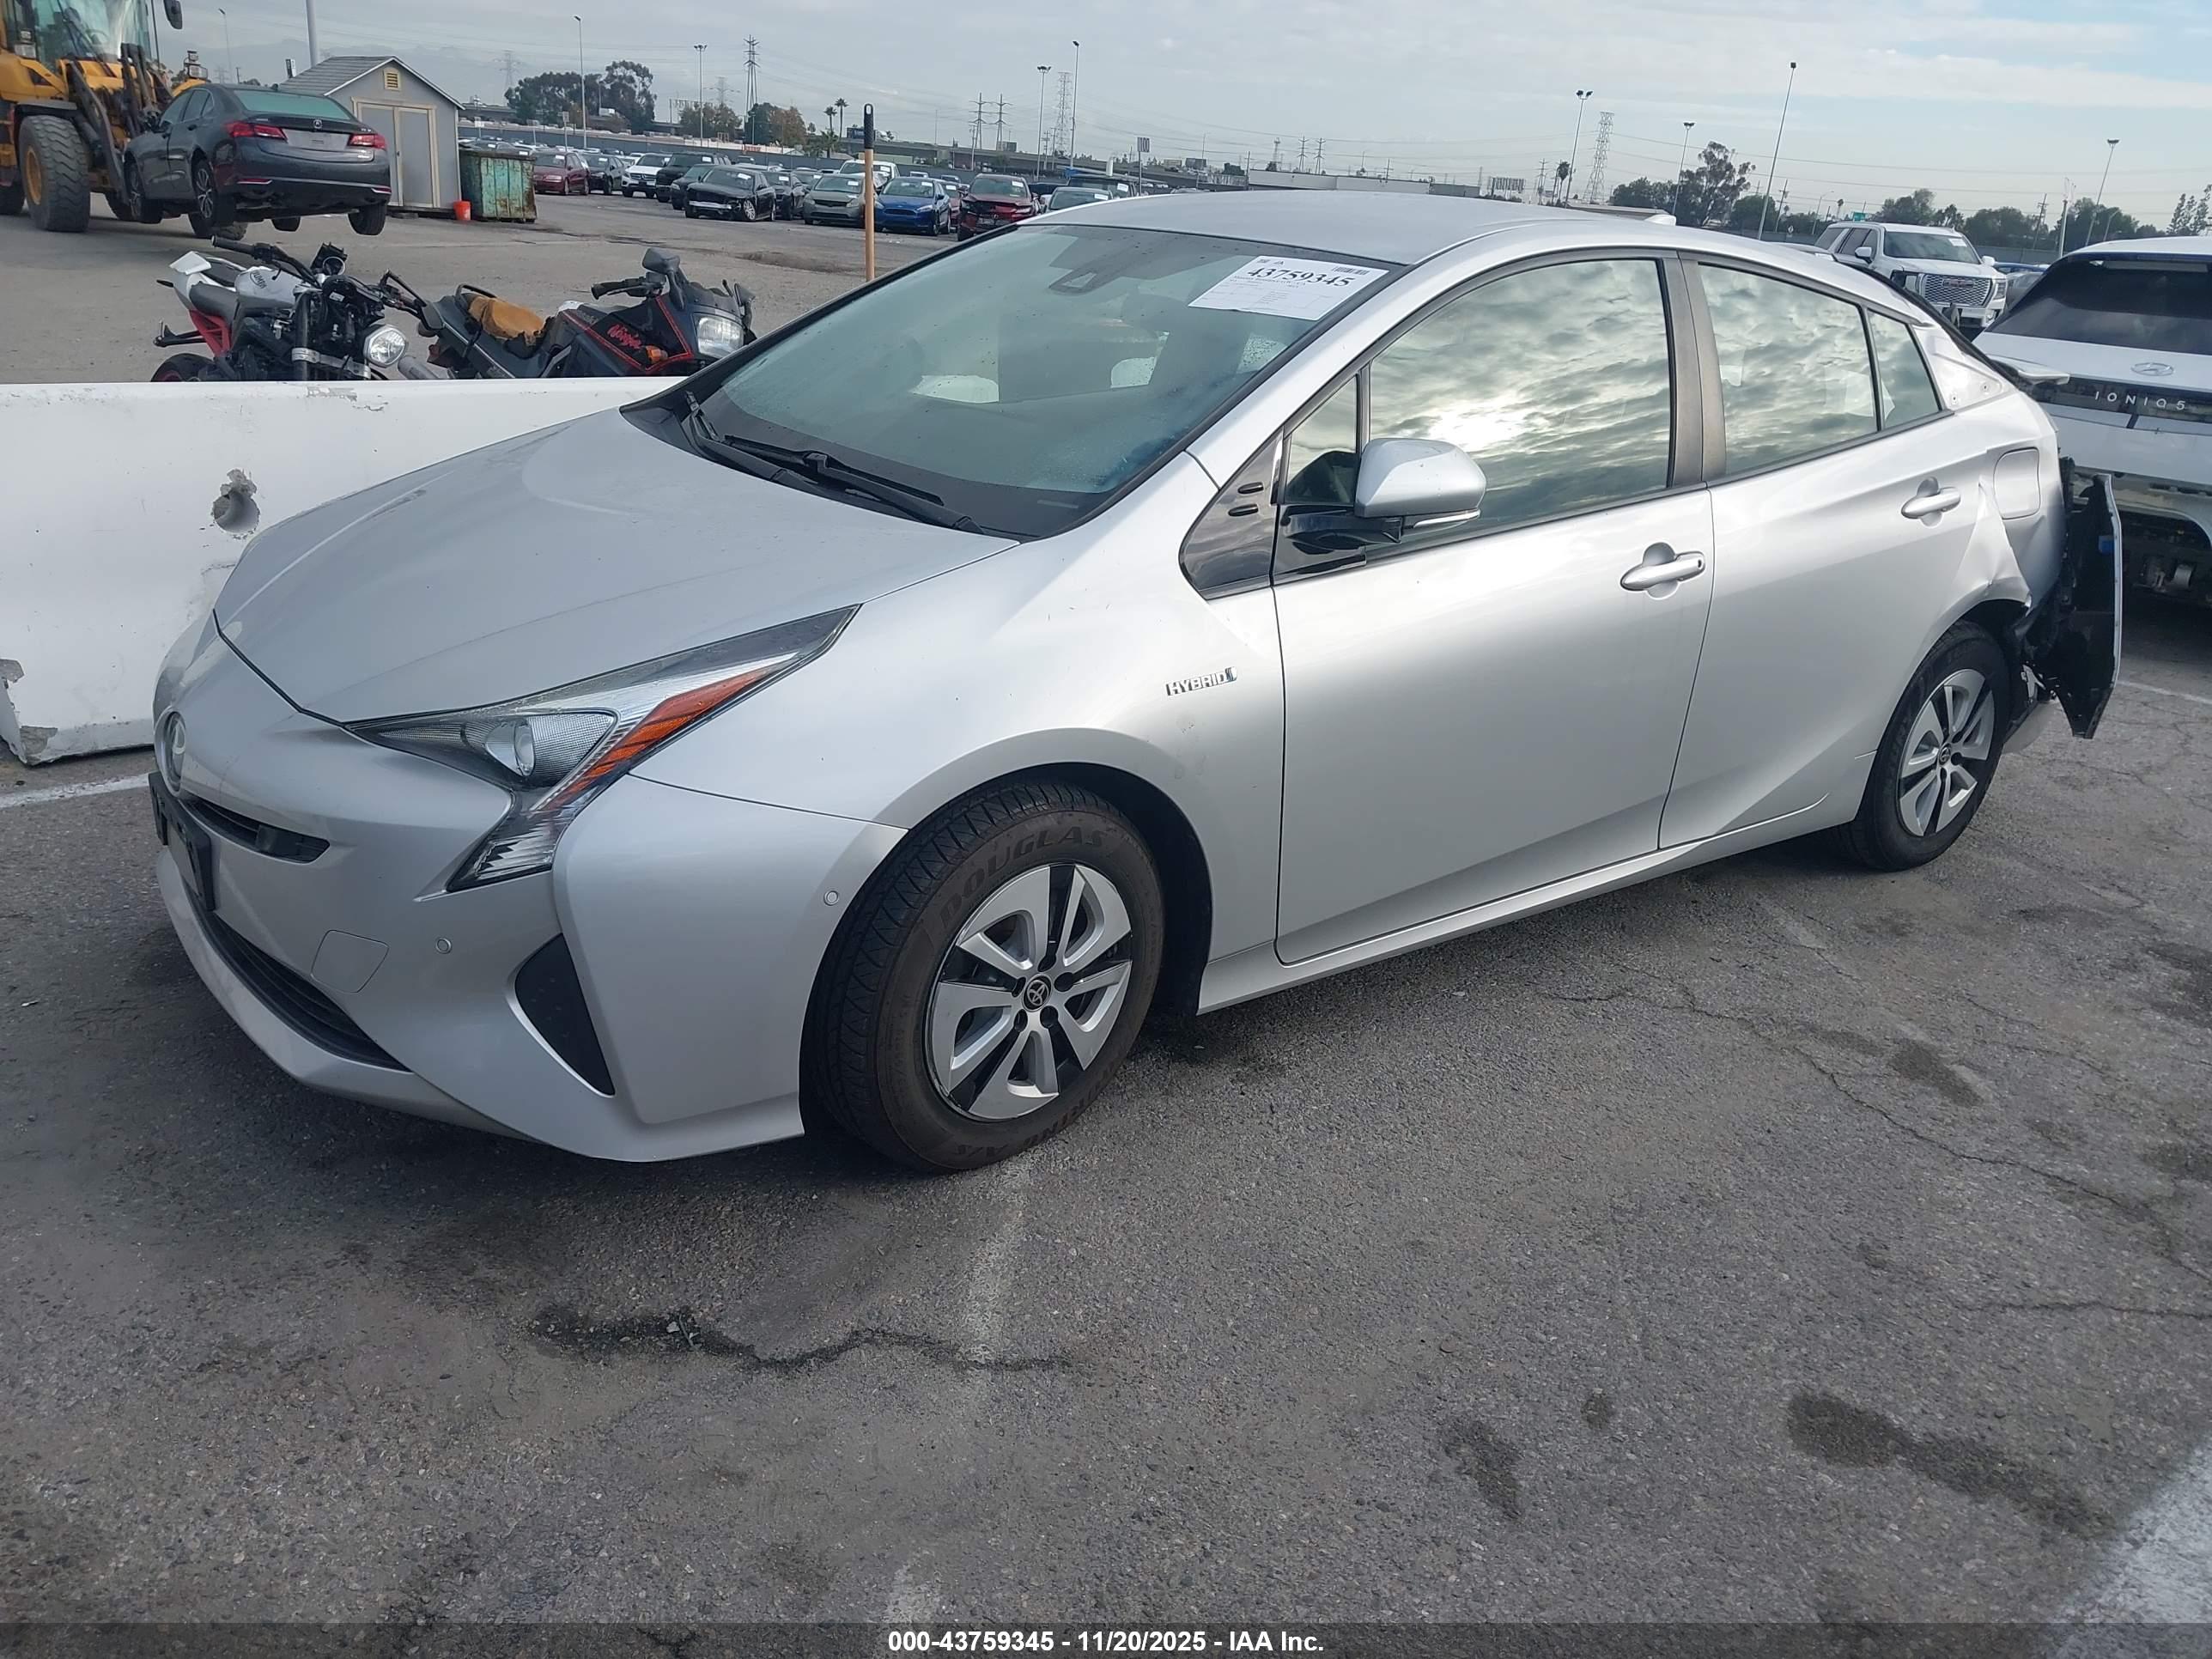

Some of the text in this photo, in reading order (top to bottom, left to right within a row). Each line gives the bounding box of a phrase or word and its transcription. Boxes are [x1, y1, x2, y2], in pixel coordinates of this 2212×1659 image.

[1248, 268, 1356, 287] 43759345
[2094, 391, 2187, 411] IONIQ 5
[1165, 671, 1226, 696] HYBRID
[939, 825, 1109, 927] DOUGLAS
